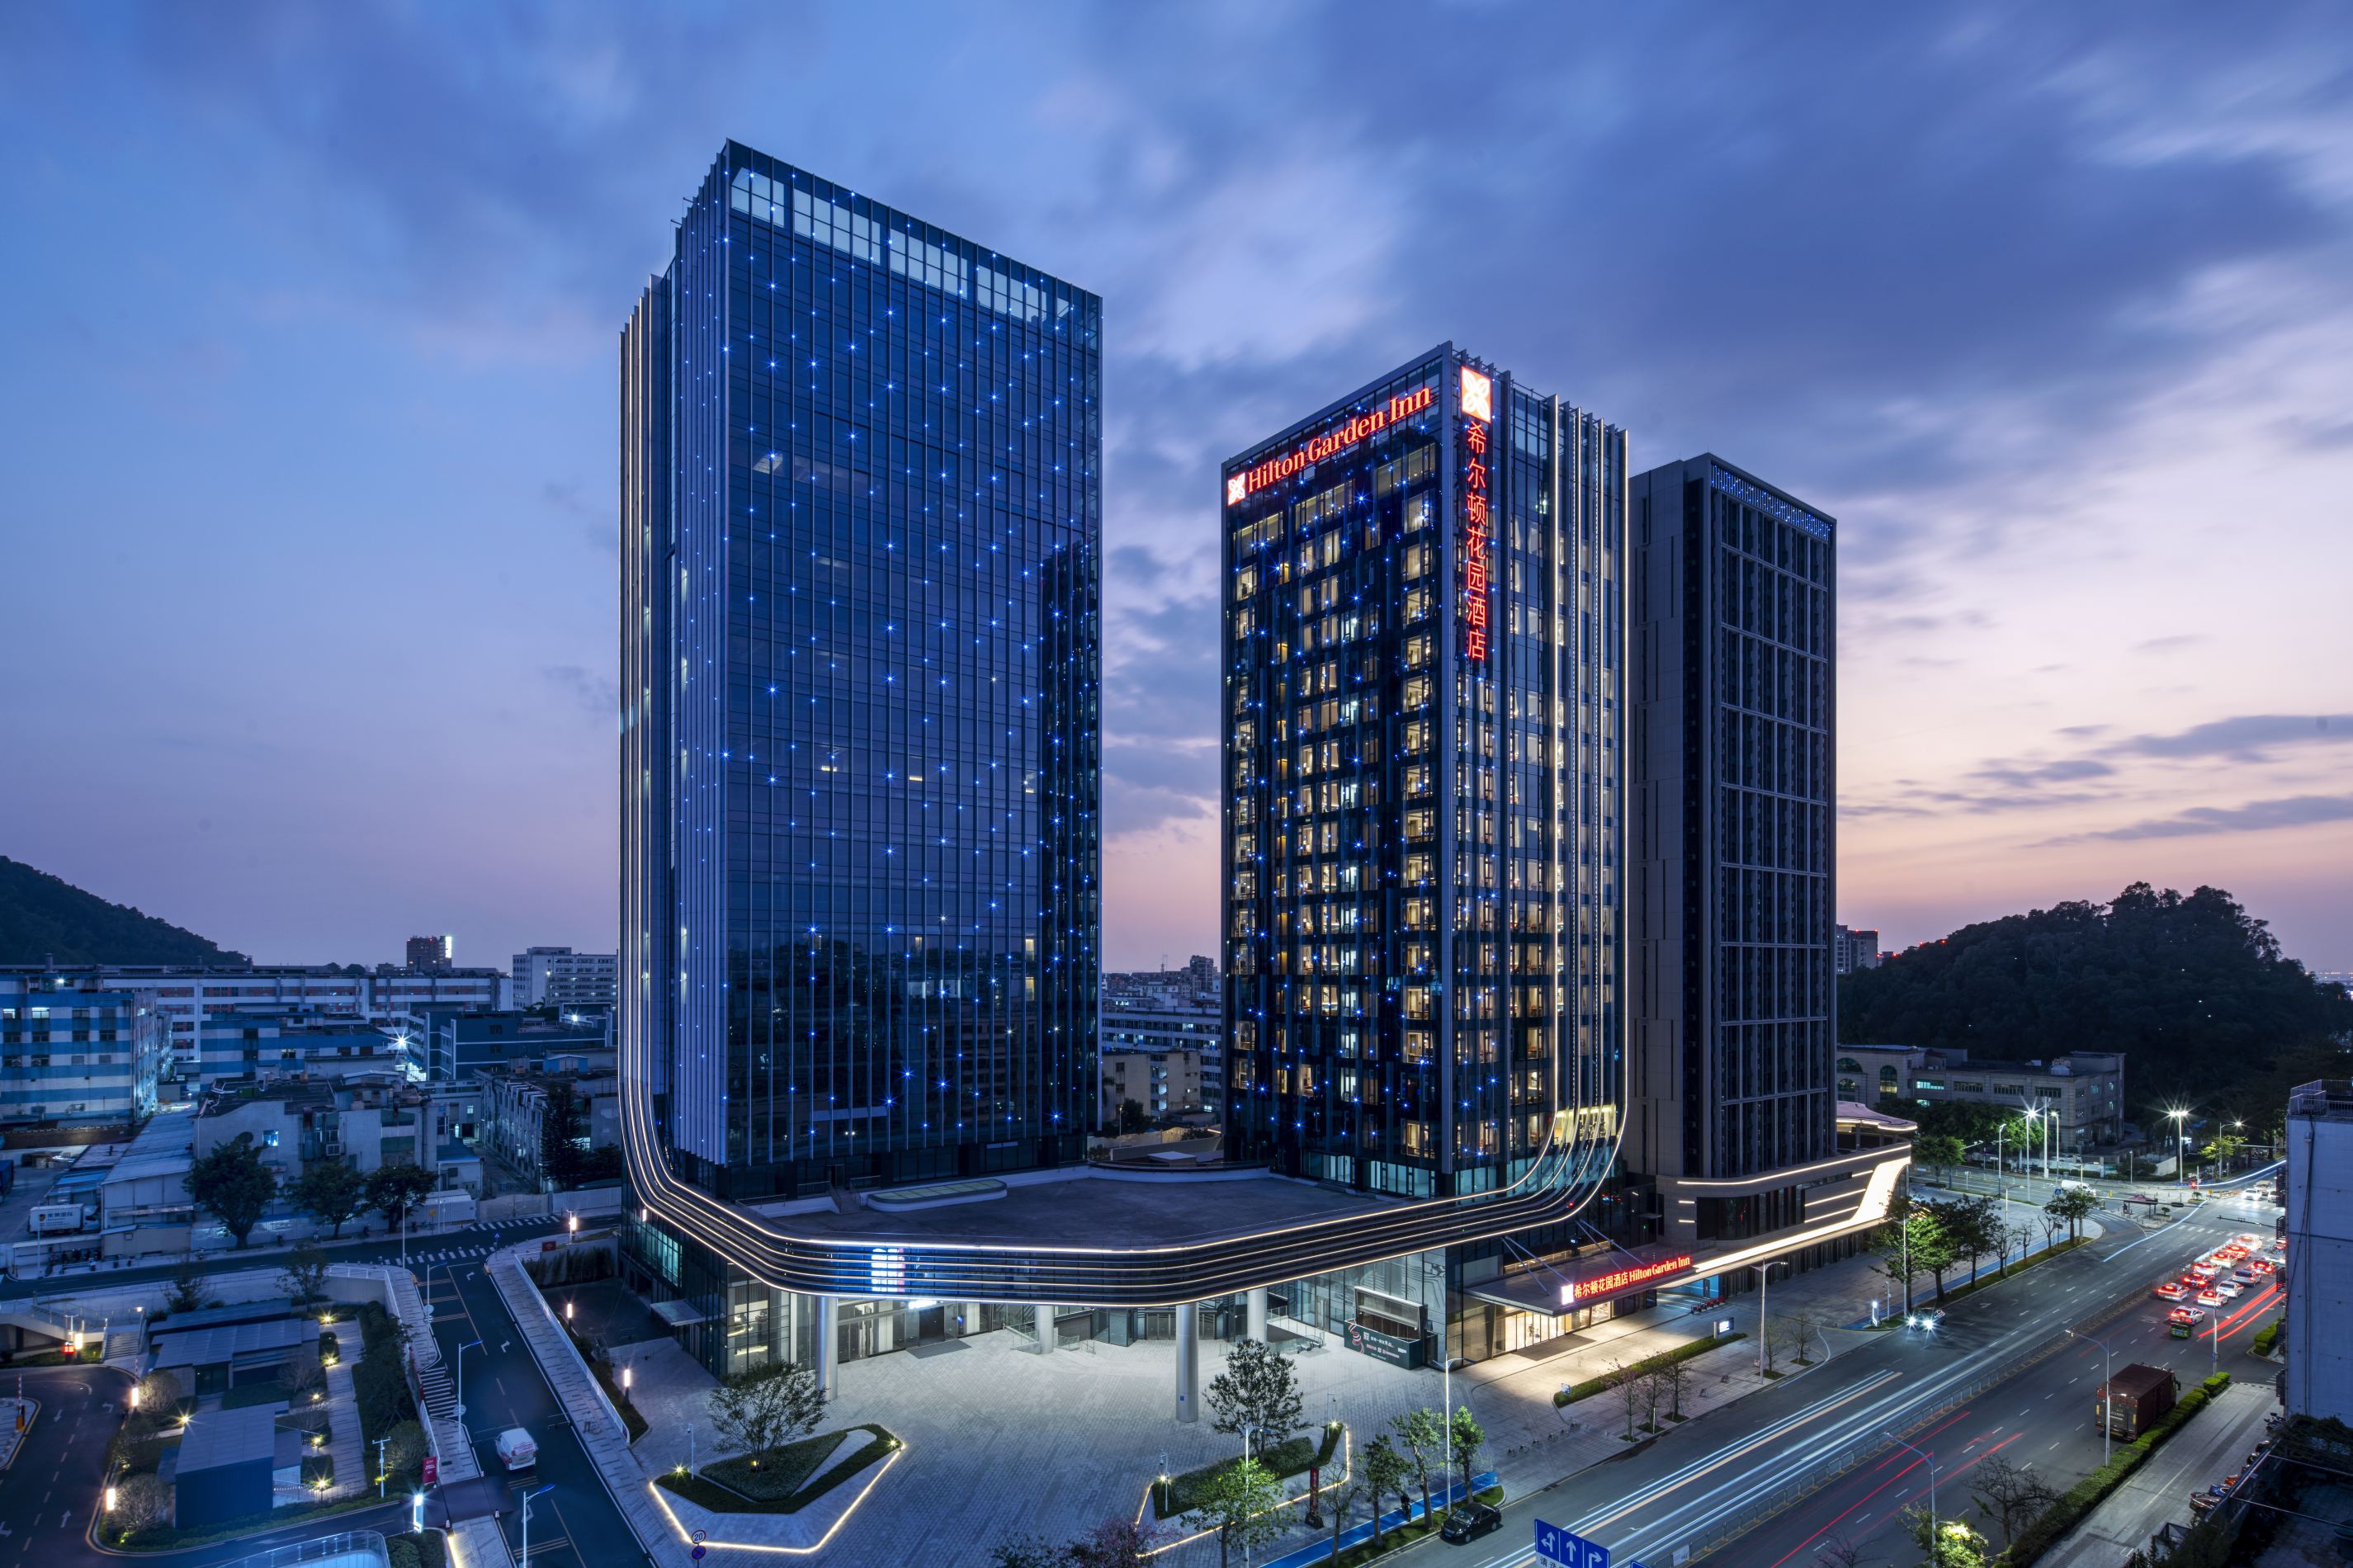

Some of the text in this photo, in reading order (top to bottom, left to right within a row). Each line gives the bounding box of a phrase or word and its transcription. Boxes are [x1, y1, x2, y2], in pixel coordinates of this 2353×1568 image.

[1248, 387, 1431, 493] Hilton Garden Inn
[1467, 421, 1486, 660] 希尔顿花园酒店
[1574, 1257, 1690, 1298] 希尔顿花园酒店 Hilton Garden Inn
[694, 1533, 703, 1541] 20
[1540, 1556, 1564, 1568] 请选
